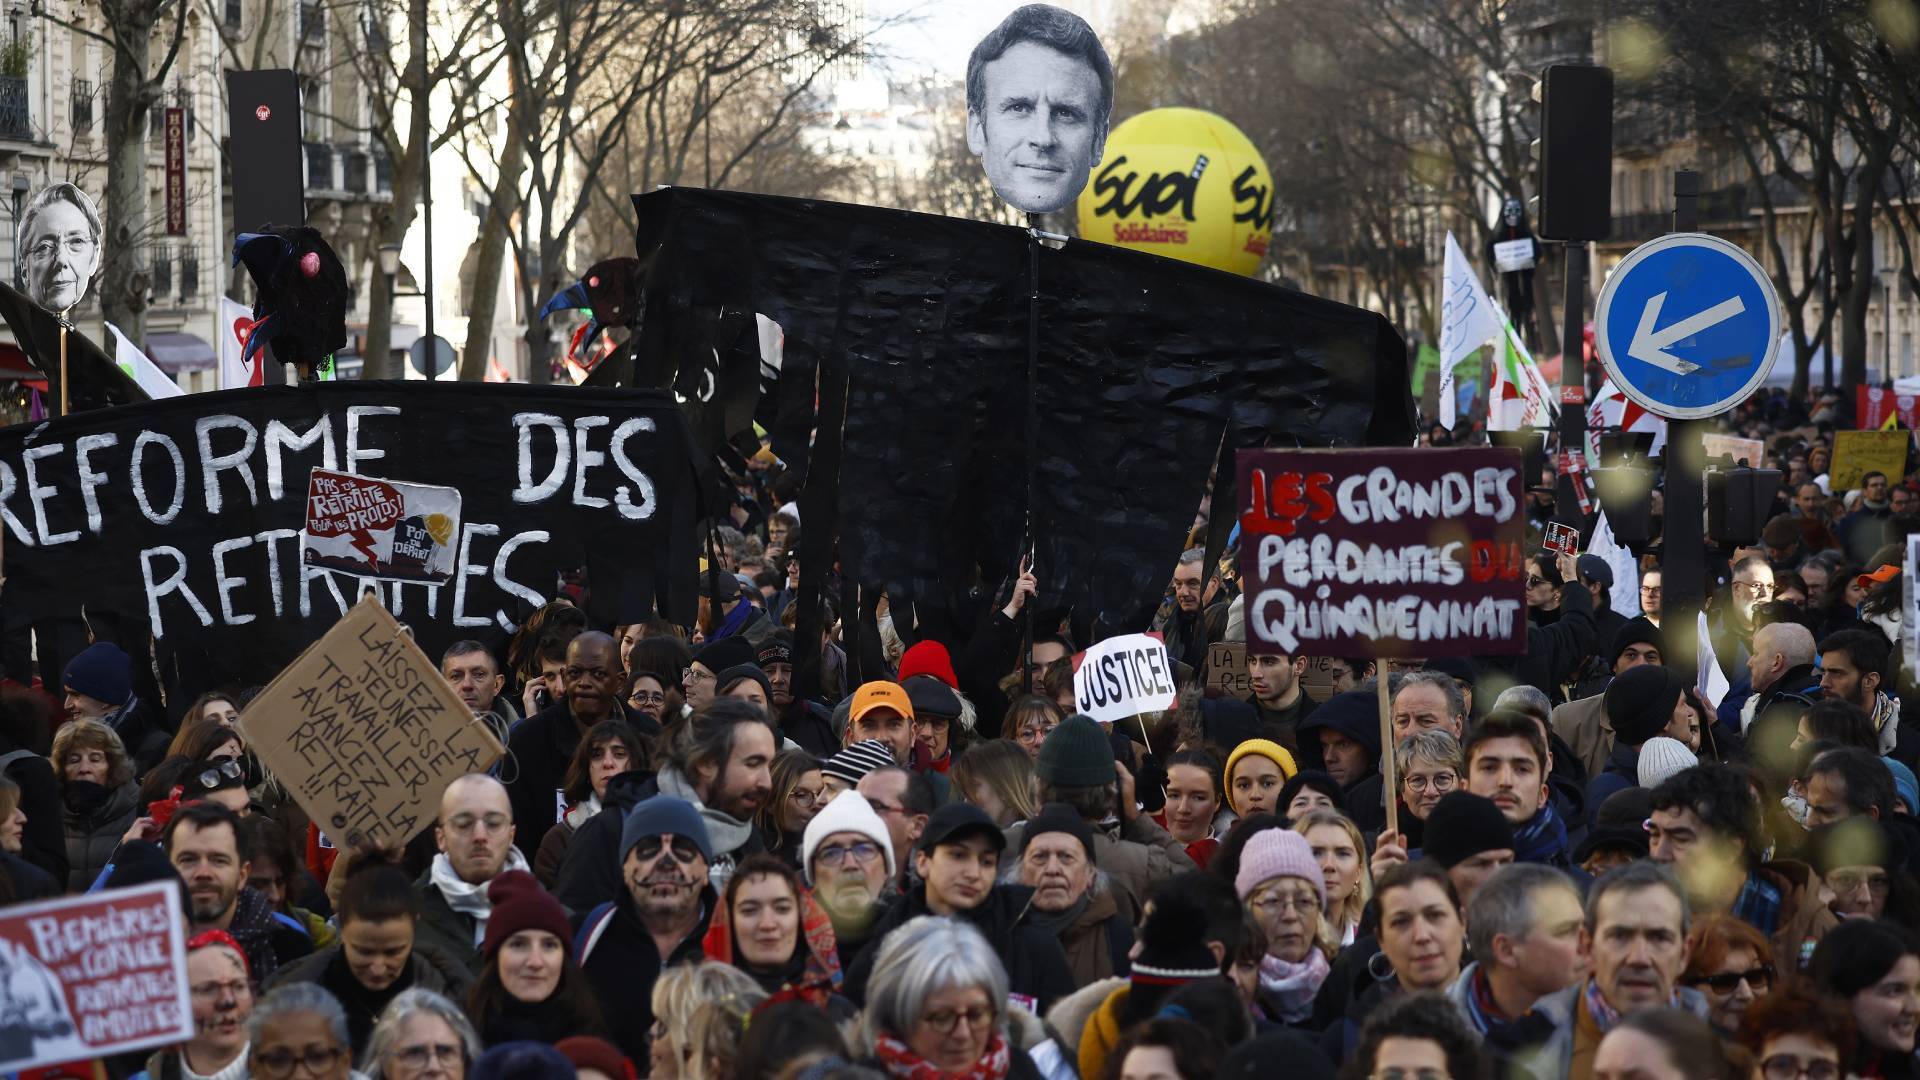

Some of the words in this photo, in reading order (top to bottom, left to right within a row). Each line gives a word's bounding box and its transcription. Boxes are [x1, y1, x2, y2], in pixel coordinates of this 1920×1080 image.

[169, 113, 181, 171] HOTEL
[1113, 222, 1189, 245] Solidaires
[0, 405, 401, 546] RÉFORME
[512, 412, 656, 520] DES
[311, 485, 387, 518] RETRAITE
[313, 477, 338, 495] PAS
[340, 480, 357, 491] DE
[1240, 468, 1336, 535] LES
[1336, 466, 1517, 525] GRANDES
[310, 518, 334, 533] POUR
[333, 518, 350, 532] LES
[346, 494, 405, 531] PROLOS!
[405, 525, 429, 539] POT
[394, 539, 430, 560] DÉPART
[411, 538, 421, 547] DE
[1258, 533, 1464, 588] PERDANTES
[1471, 539, 1521, 583] DU
[1080, 646, 1173, 713] JUSTICE!
[1213, 649, 1234, 669] LA
[357, 659, 454, 777] JEUNESSE
[358, 622, 446, 722] LAISSEZ
[443, 727, 482, 771] LA
[316, 654, 430, 806] TRAVAILLER,
[286, 722, 394, 844] RETRAITE
[292, 686, 391, 801] AVANCEZ
[386, 801, 419, 838] LA
